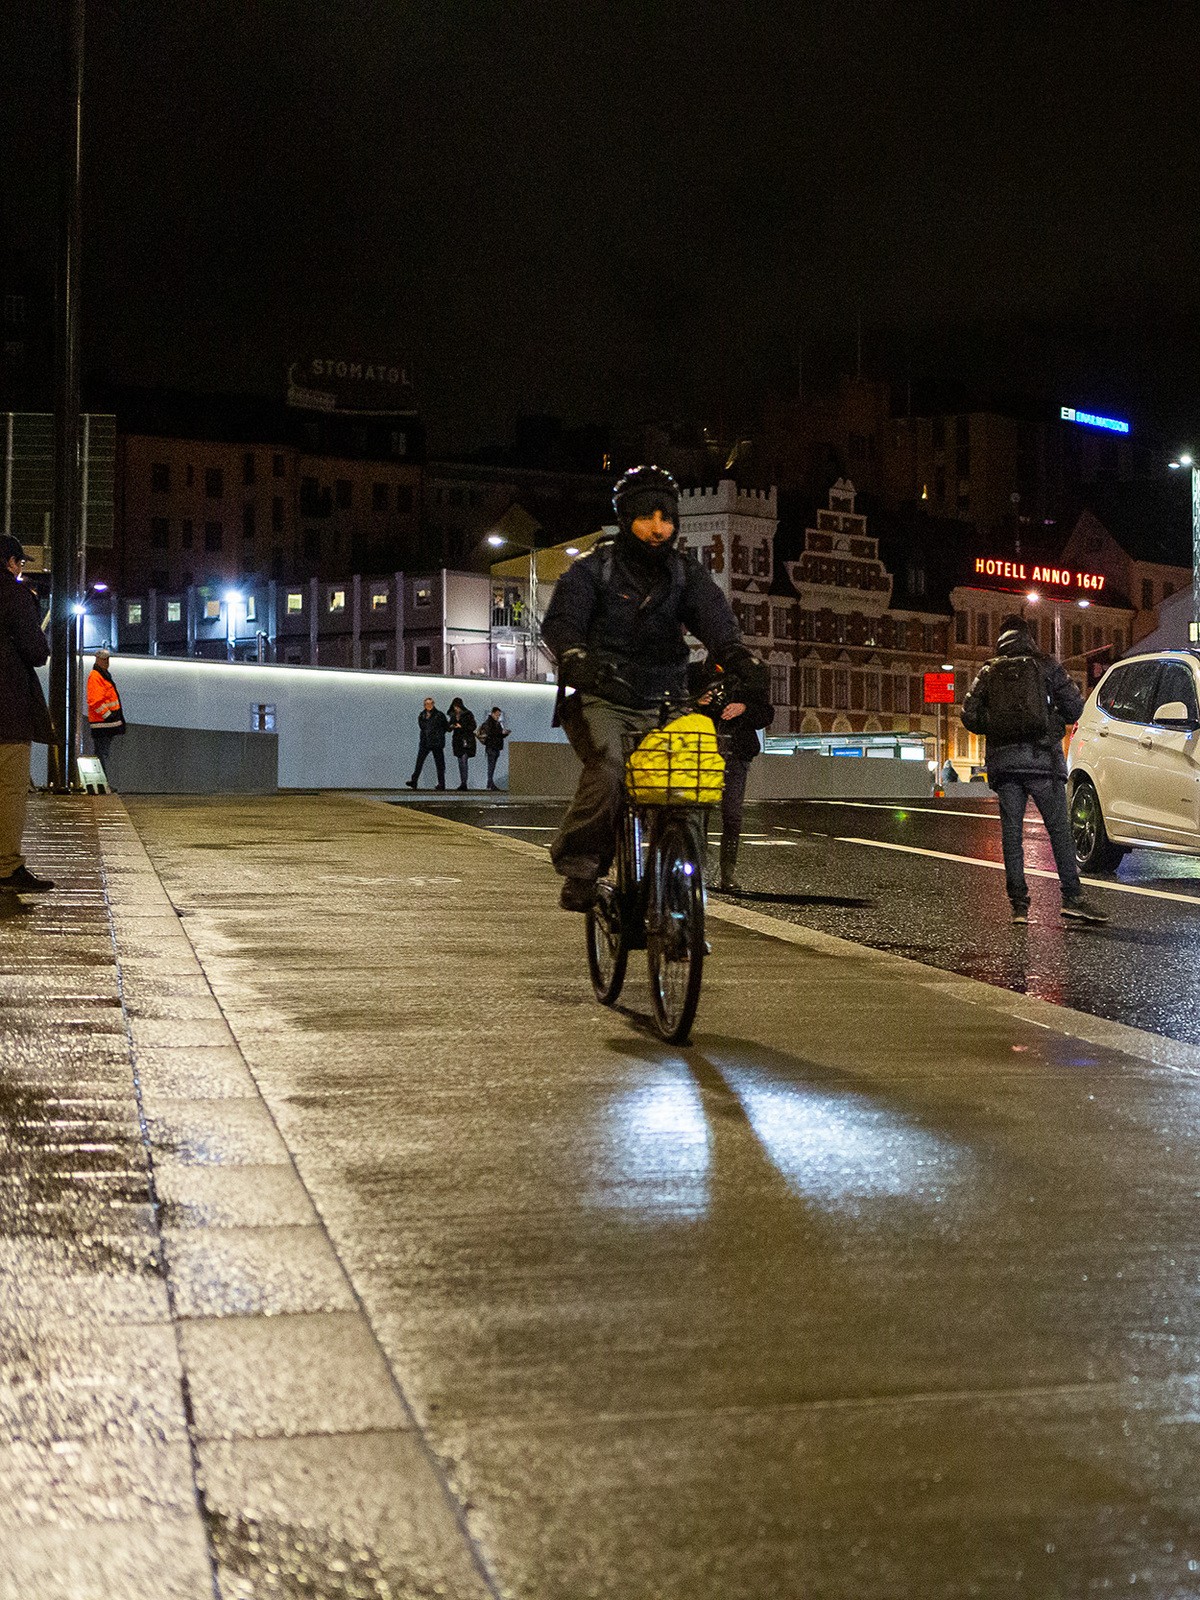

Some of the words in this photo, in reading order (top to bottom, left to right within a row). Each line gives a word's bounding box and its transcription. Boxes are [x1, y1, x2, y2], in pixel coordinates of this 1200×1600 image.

[312, 359, 410, 385] STOMATOL
[975, 558, 1026, 580] HOTELL
[1032, 566, 1070, 585] ANNO
[1076, 573, 1105, 590] 1647
